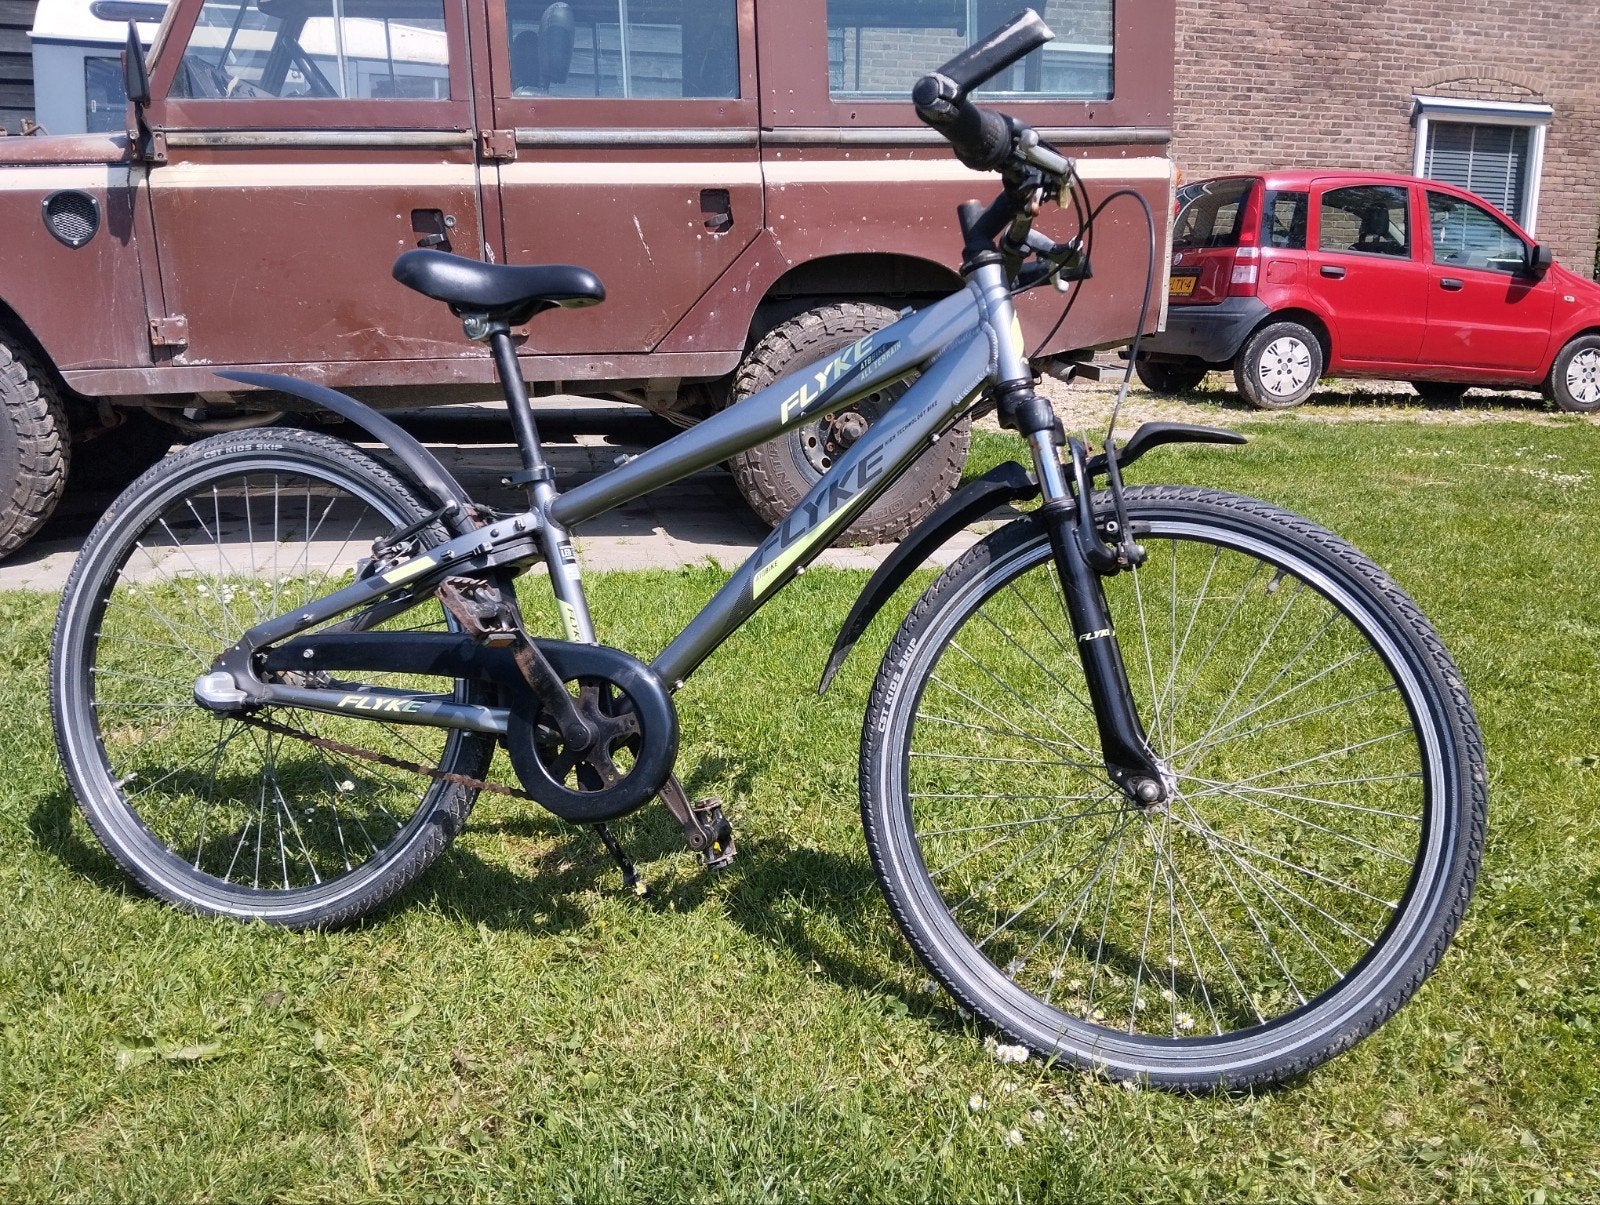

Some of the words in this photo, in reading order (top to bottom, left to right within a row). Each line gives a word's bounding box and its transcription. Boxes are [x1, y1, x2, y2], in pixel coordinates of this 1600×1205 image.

[861, 369, 873, 381] ALL
[873, 341, 901, 369] TERRAIN
[781, 338, 873, 425] FLYKE
[927, 400, 939, 412] BIKE
[203, 449, 222, 459] CST
[225, 444, 252, 454] KIDS
[255, 443, 283, 451] SKIP
[754, 444, 884, 571] FLYKE
[337, 695, 426, 713] FLYKE
[878, 707, 889, 732] CST
[885, 671, 901, 706] KIDS
[898, 637, 917, 669] SKIP
